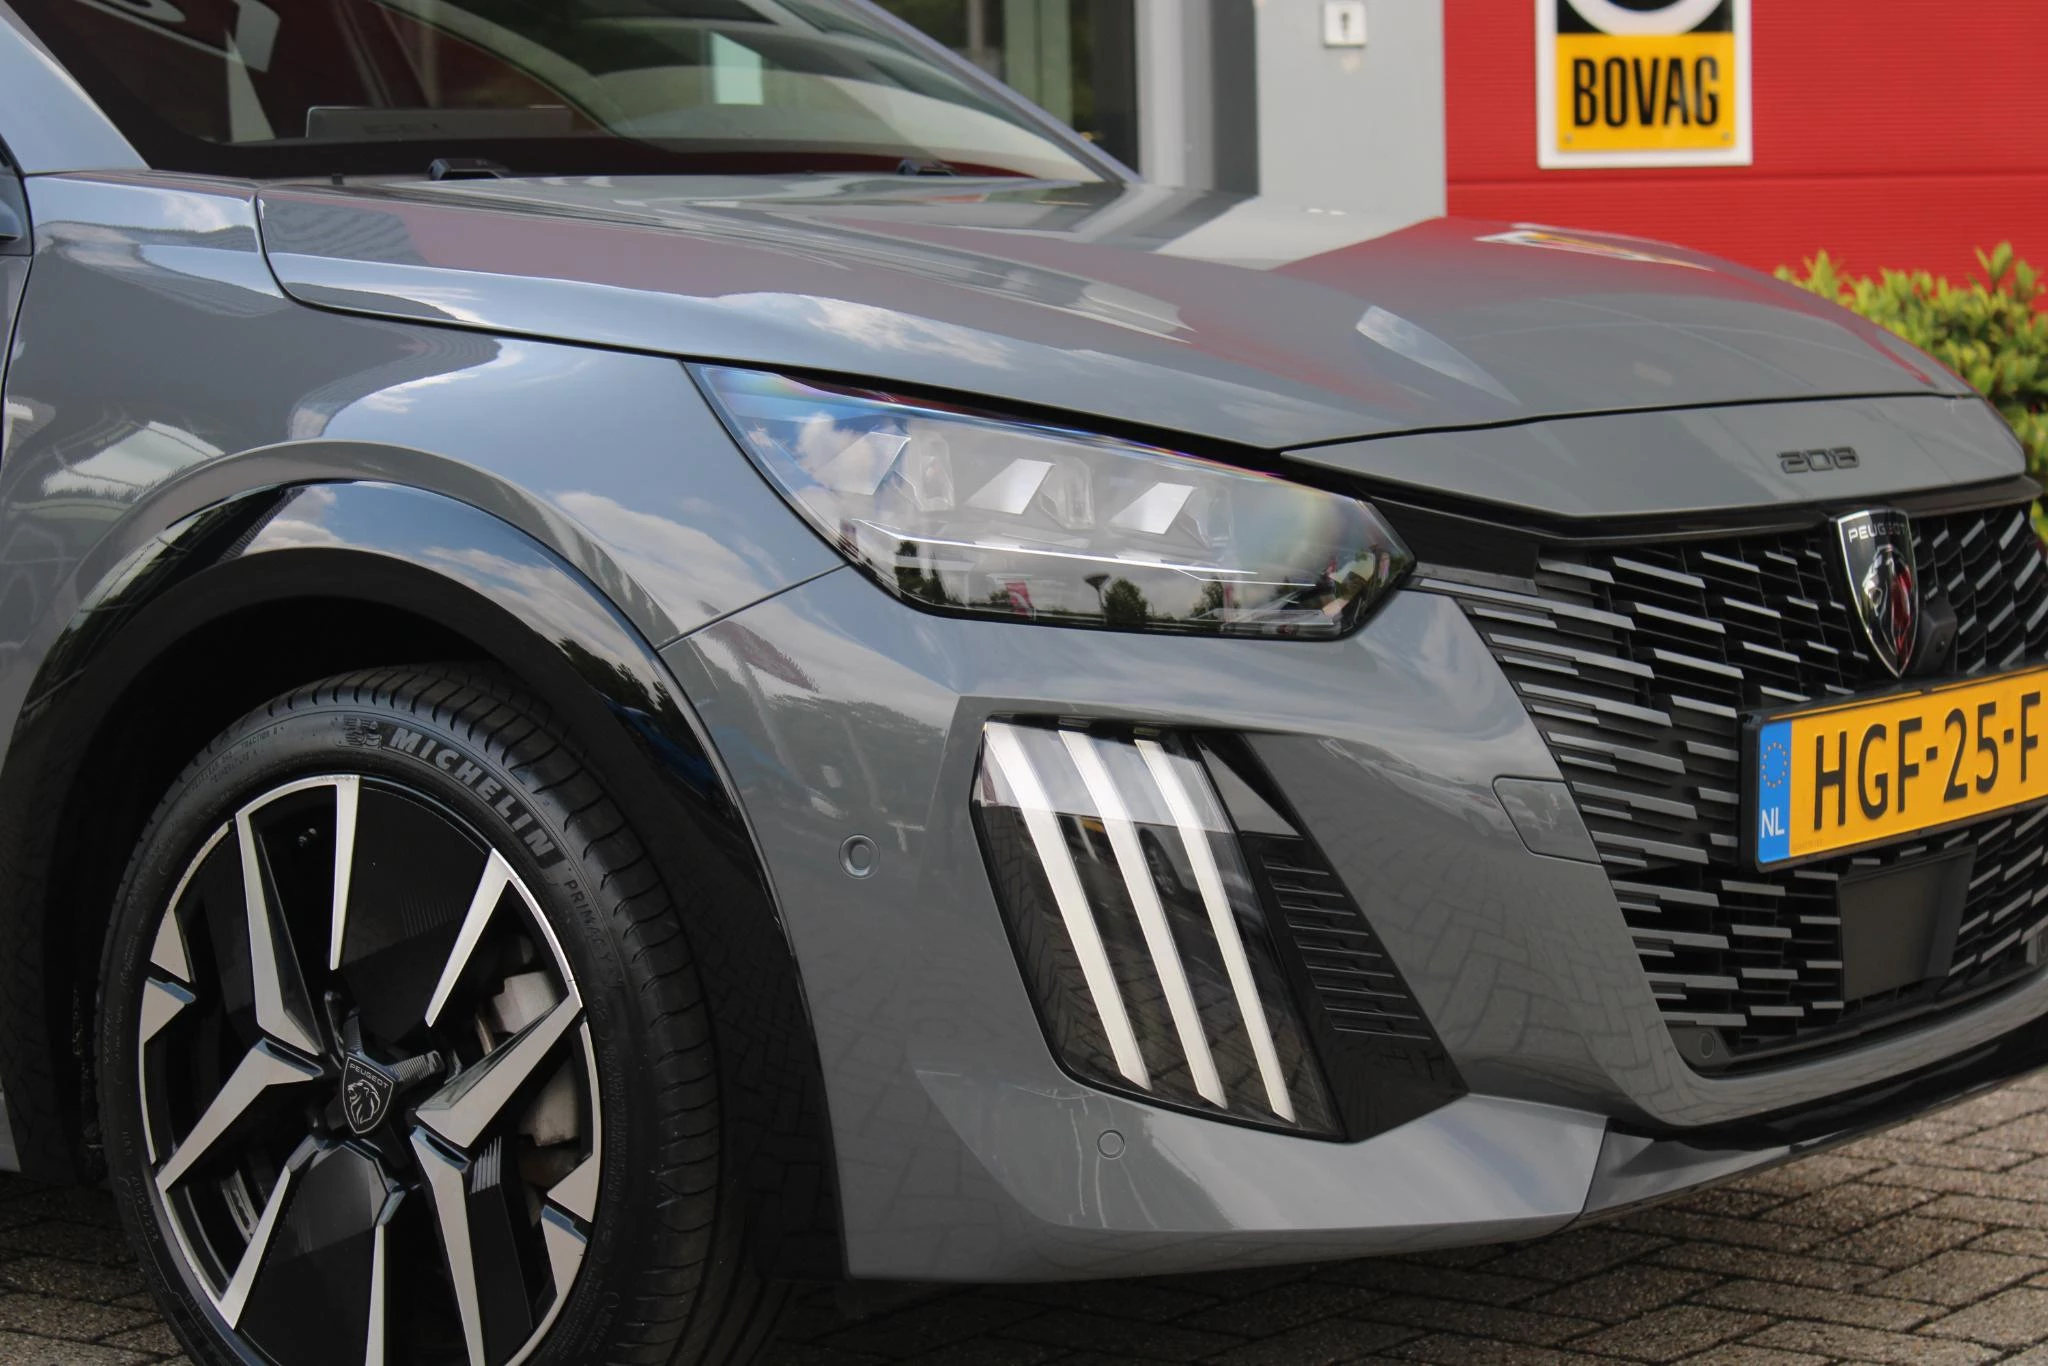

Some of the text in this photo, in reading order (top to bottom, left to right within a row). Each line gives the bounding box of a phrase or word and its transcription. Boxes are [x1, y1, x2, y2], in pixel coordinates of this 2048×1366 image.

[1572, 56, 1720, 128] BOVAG
[1777, 446, 1859, 473] 208
[1848, 521, 1906, 543] PEUGEOT
[1814, 691, 2041, 831] HGF-25-F
[389, 726, 558, 858] MICHELIN
[1761, 807, 1785, 838] NL
[349, 1062, 389, 1089] PEUGEOT
